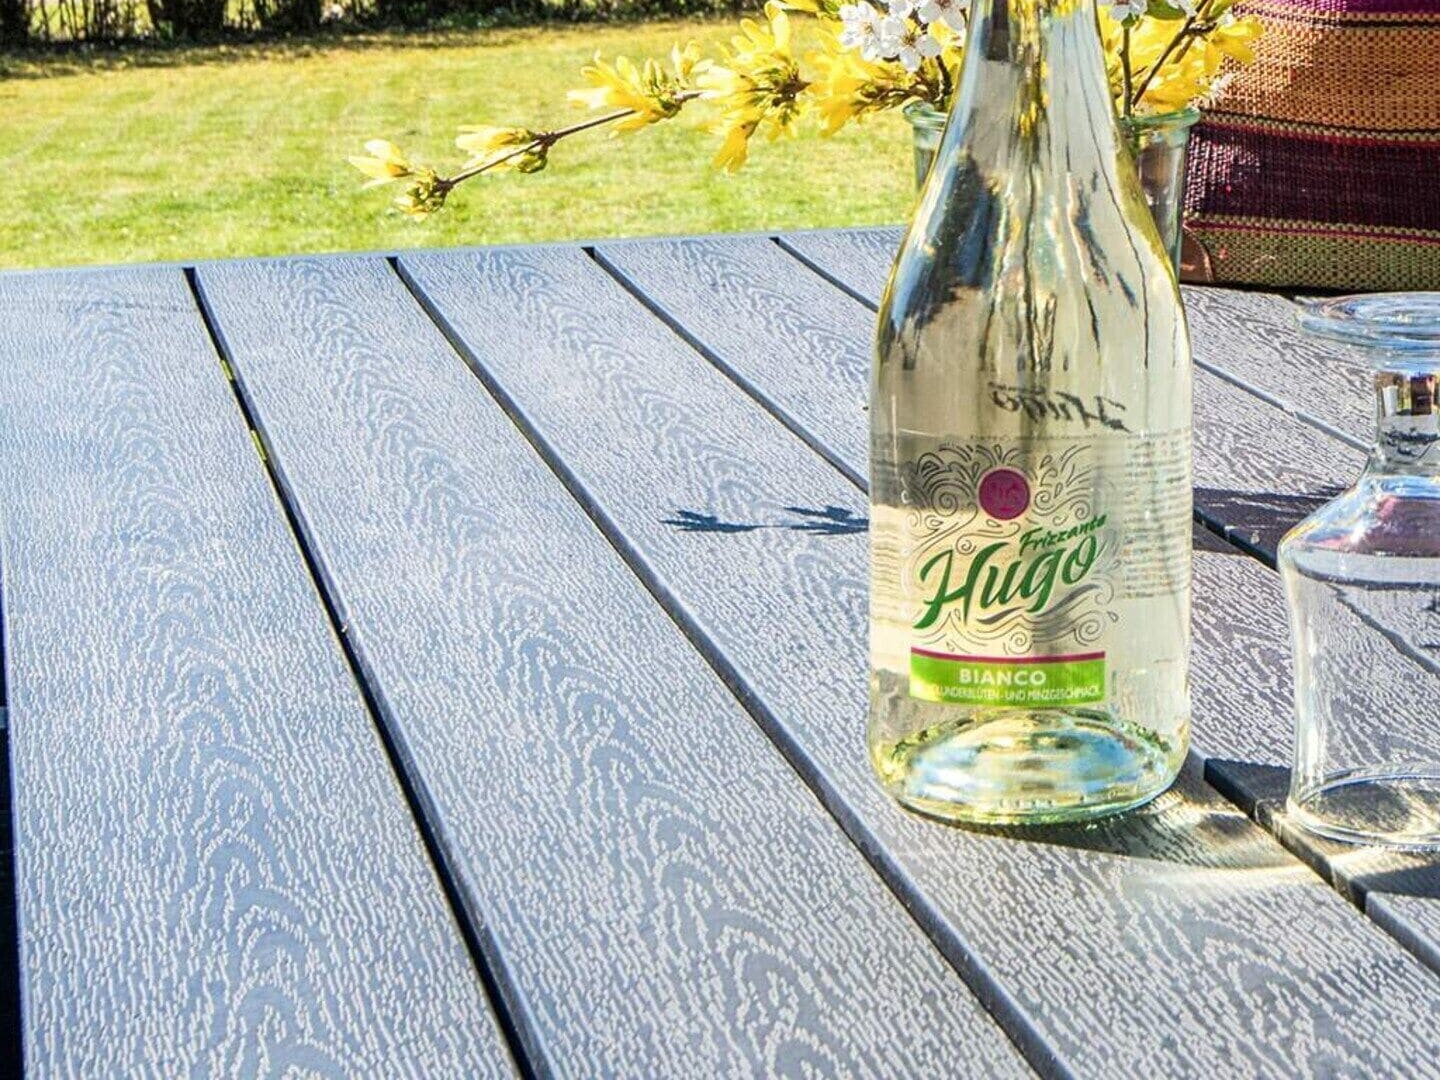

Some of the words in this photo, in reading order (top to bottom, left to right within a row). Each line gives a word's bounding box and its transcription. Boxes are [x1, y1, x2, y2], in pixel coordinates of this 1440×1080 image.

[1019, 514, 1107, 556] Frizzante
[912, 534, 1107, 630] Hugo
[958, 668, 1047, 686] BIANCO
